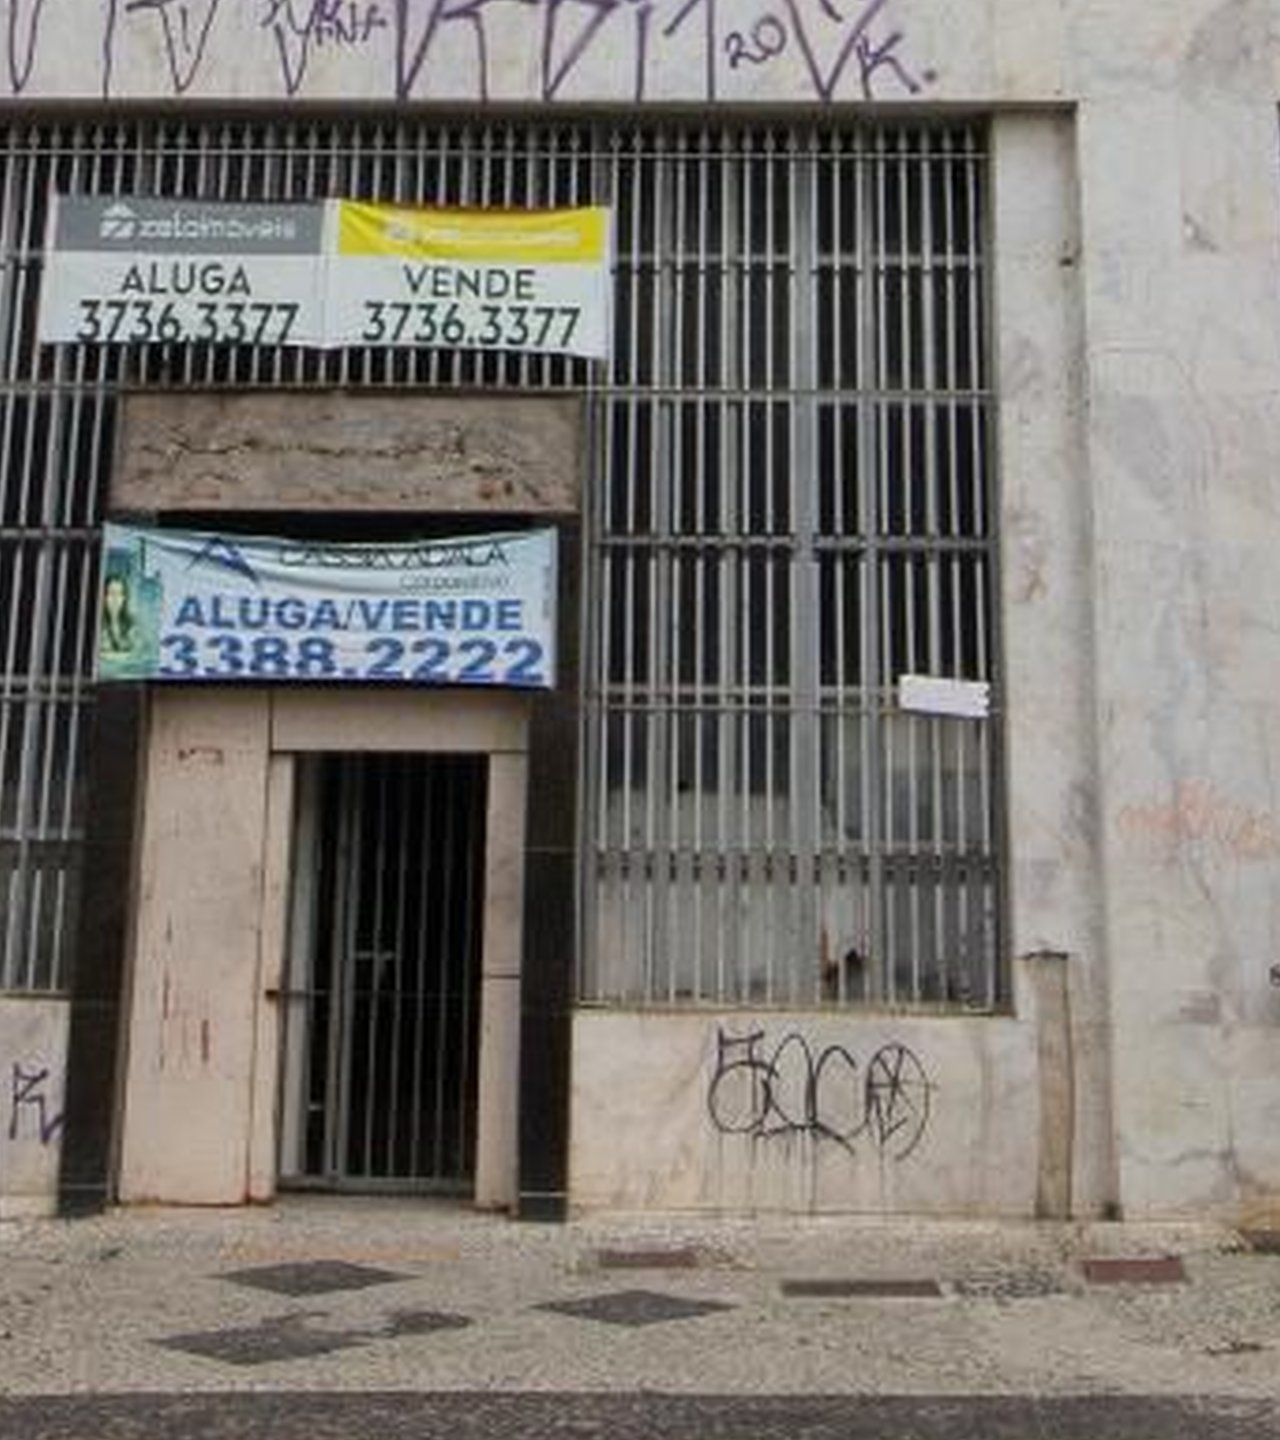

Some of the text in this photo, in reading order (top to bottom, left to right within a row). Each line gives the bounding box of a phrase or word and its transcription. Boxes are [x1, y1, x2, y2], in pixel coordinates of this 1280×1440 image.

[121, 262, 251, 295] ALUGA
[403, 264, 536, 300] VENDE
[76, 299, 300, 344] 3736.3377
[361, 302, 582, 348] 3736.3377
[174, 598, 524, 631] ALUGA/VENDE
[158, 633, 546, 683] 3388.2222
